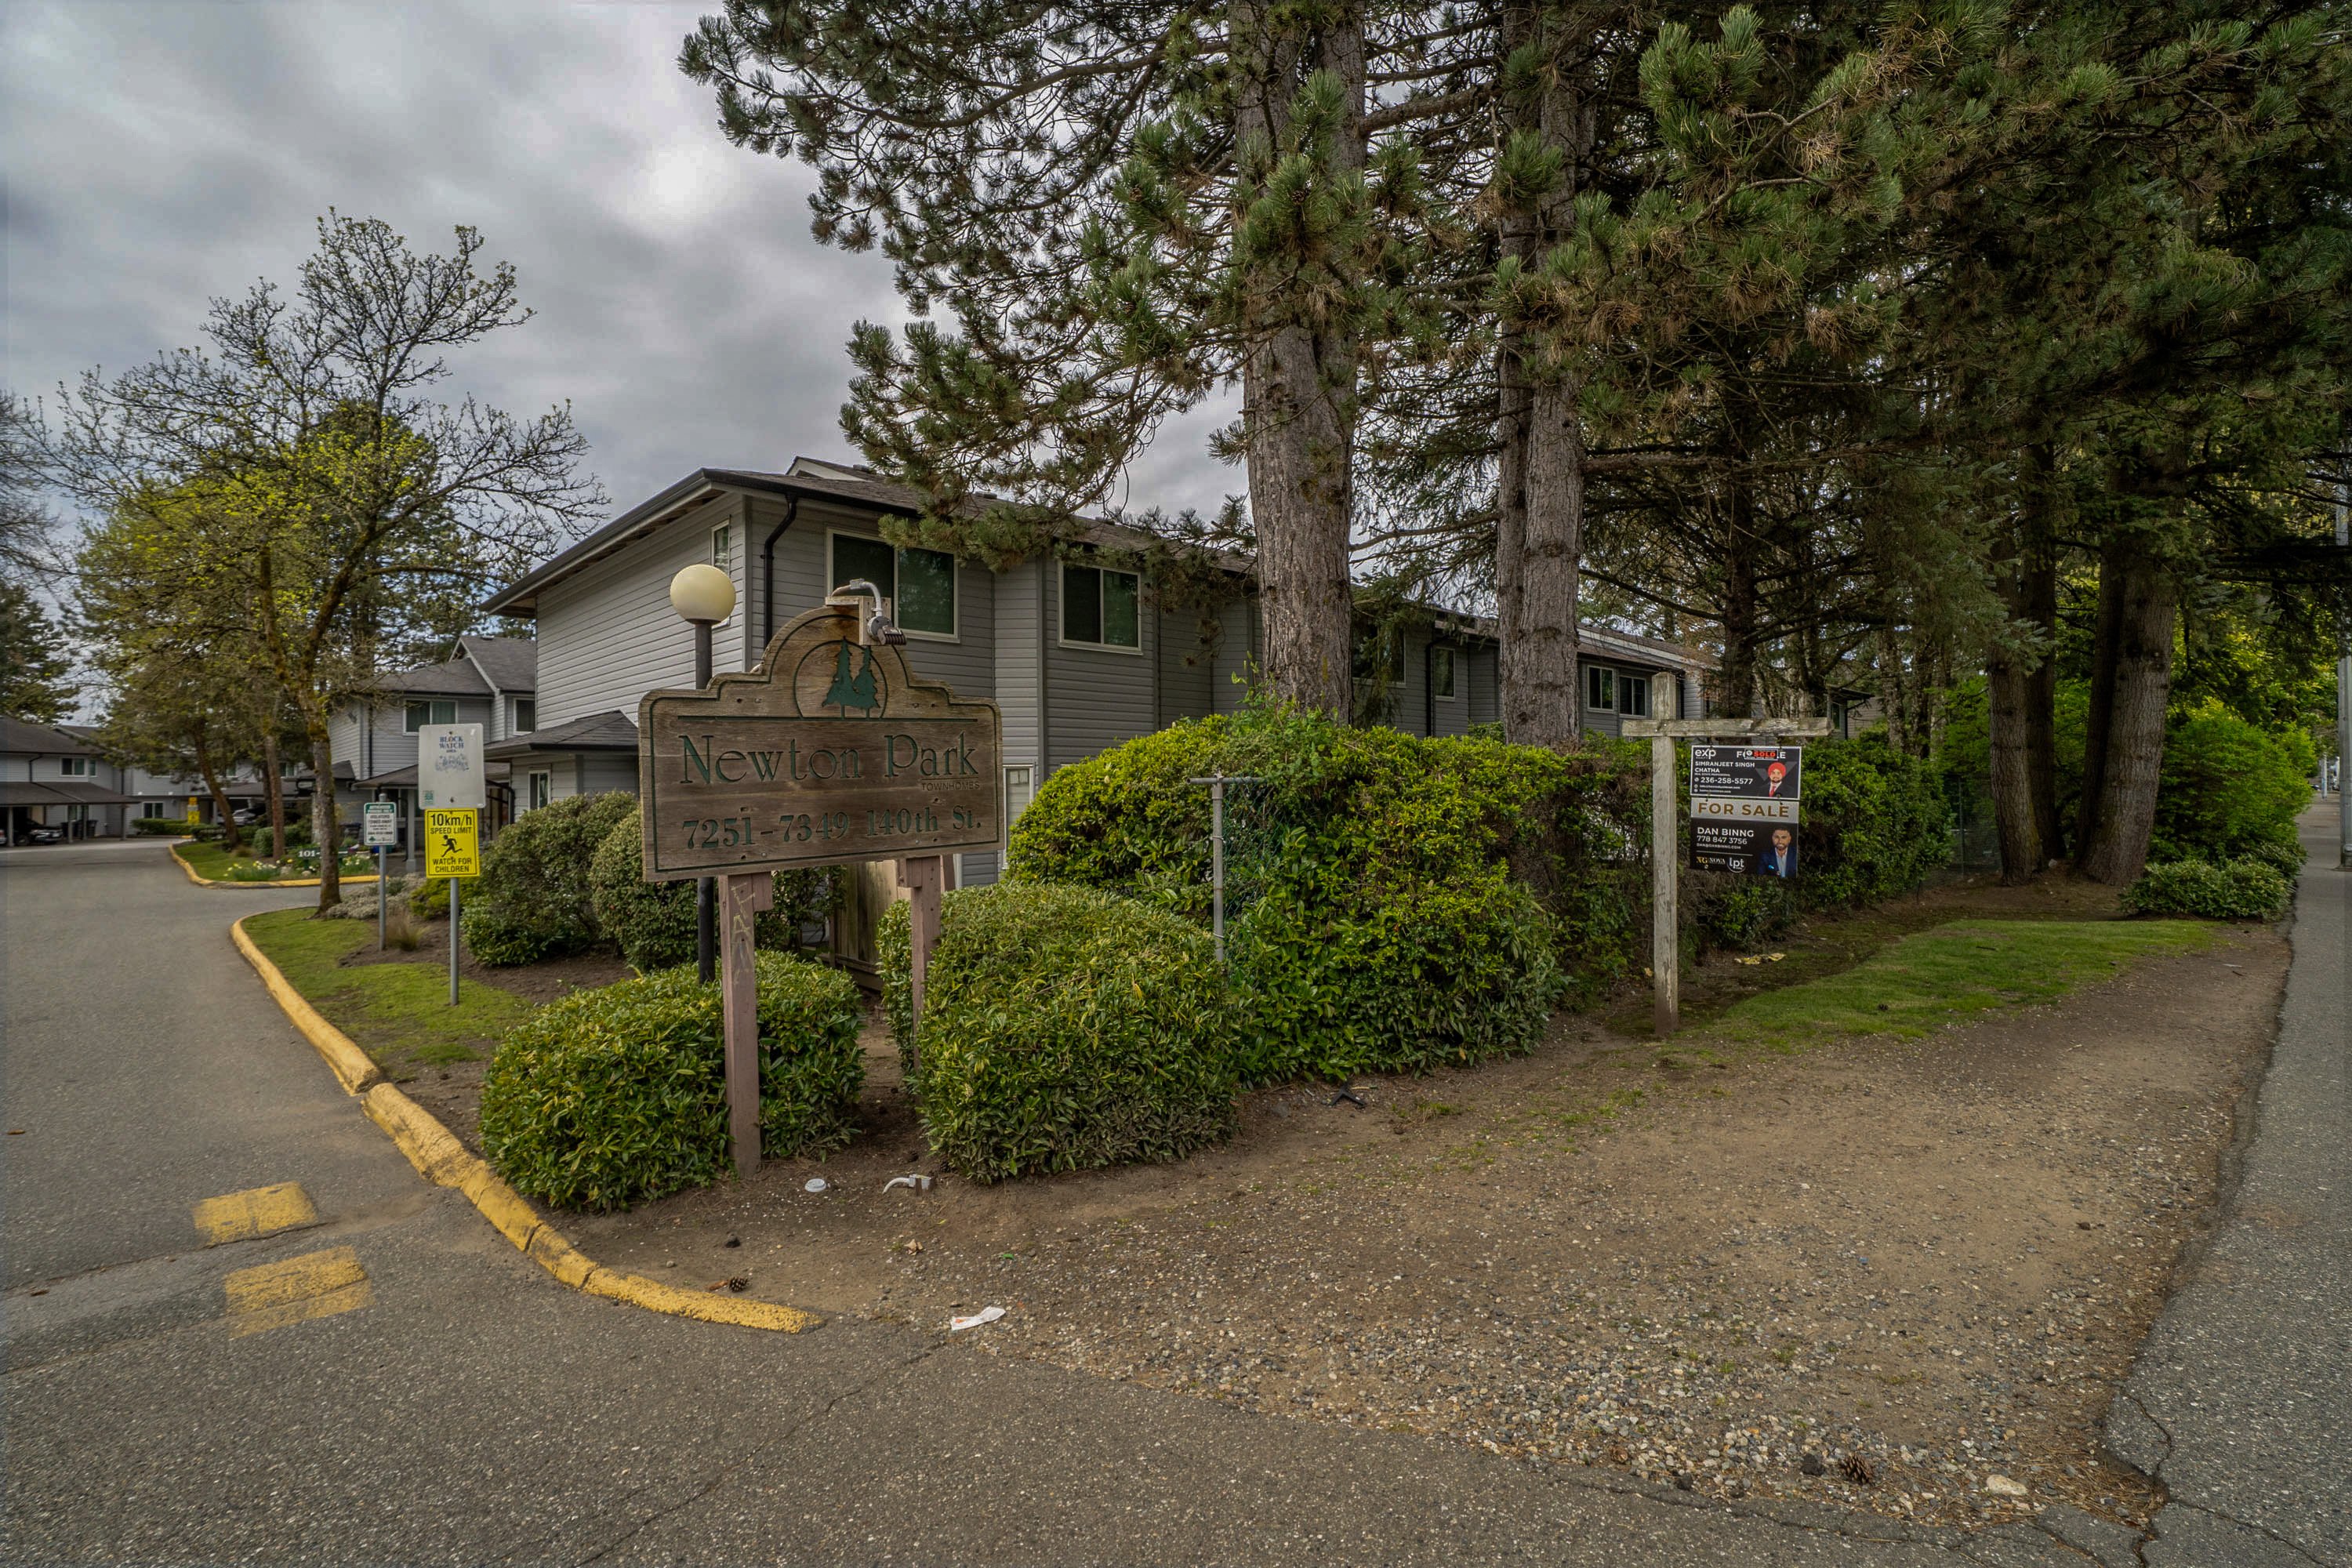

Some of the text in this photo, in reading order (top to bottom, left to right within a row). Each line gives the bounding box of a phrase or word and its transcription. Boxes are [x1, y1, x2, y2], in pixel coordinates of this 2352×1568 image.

[678, 731, 979, 785] Newton Park
[921, 782, 980, 791] TOWNHOMES
[1698, 803, 1789, 818] FOR SALE
[430, 813, 472, 826] 10km/h
[867, 807, 938, 837] 140th
[953, 805, 982, 830] St.
[1722, 828, 1754, 837] BINNG
